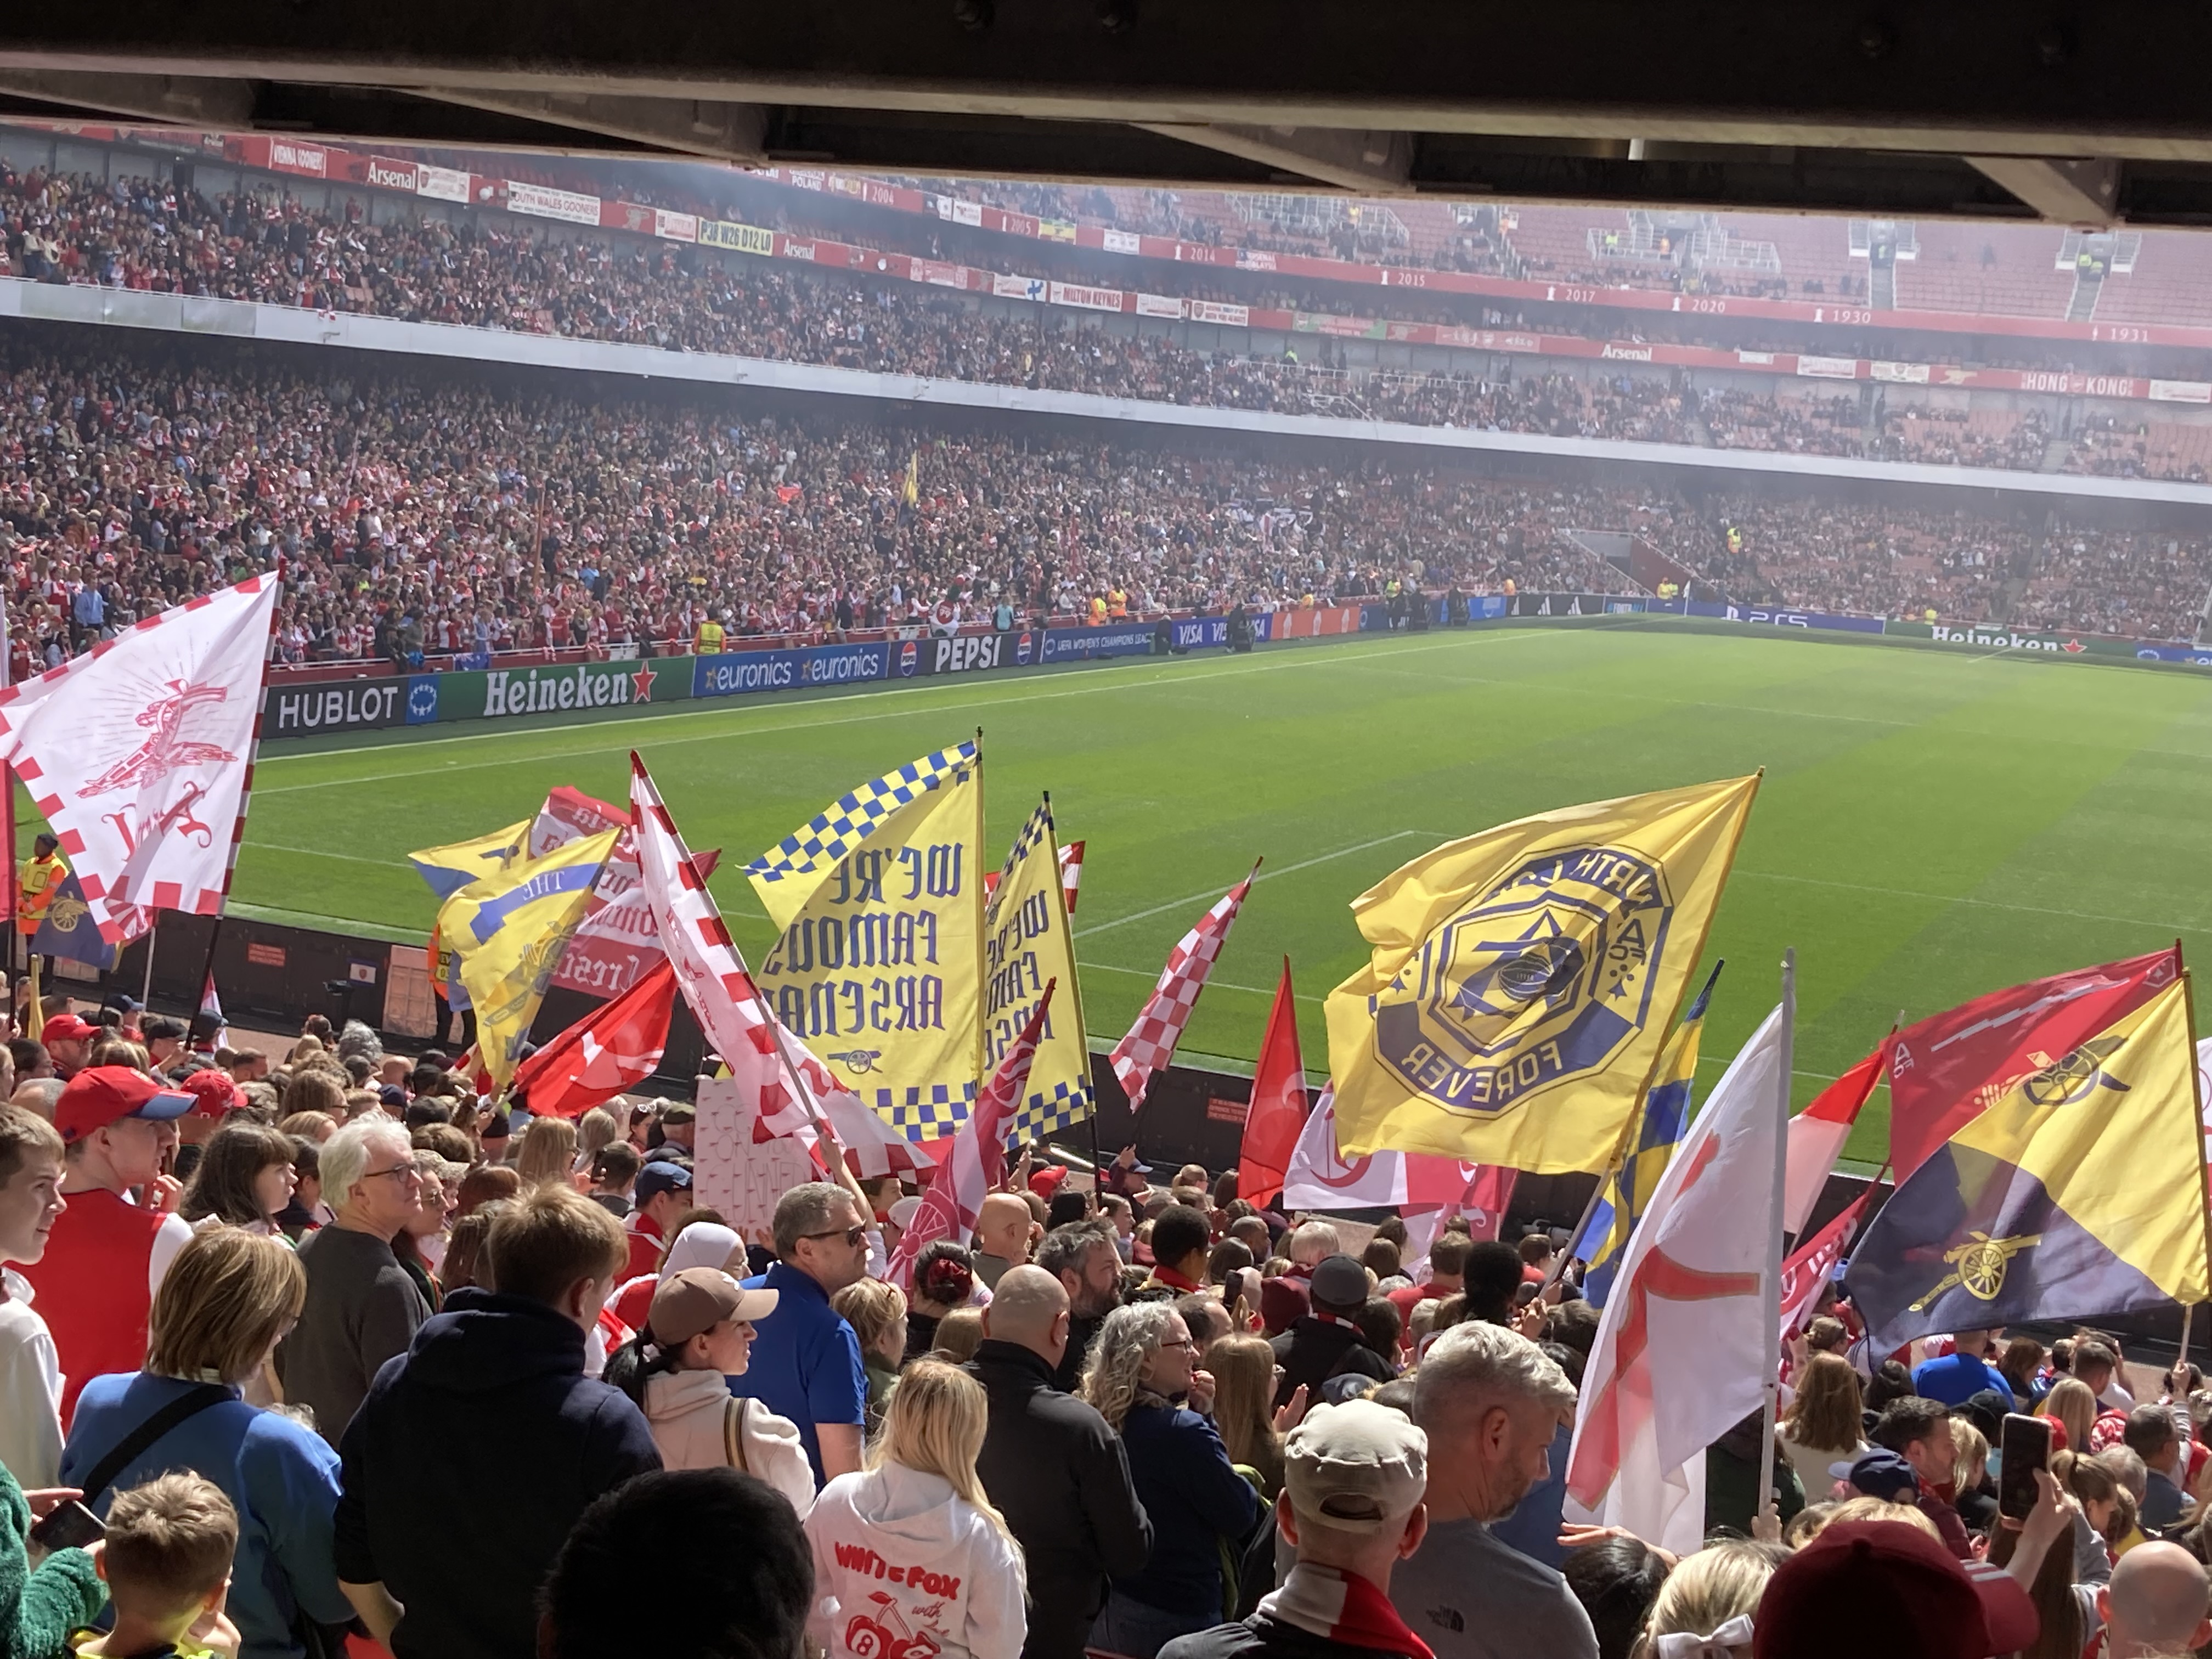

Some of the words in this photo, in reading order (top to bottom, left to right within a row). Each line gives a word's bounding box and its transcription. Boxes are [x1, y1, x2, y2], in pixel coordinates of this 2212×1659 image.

[367, 162, 416, 190] Arsenal
[792, 175, 822, 191] POLAND
[537, 194, 562, 210] WALES
[564, 201, 599, 216] GOONERS
[872, 186, 894, 205] 2004
[1011, 217, 1031, 235] 2005
[742, 228, 759, 250] D12
[783, 239, 815, 261] Arsenal
[1190, 247, 1215, 262] 2014
[1398, 273, 1425, 287] 2015
[1063, 287, 1091, 304] MILTON
[1093, 291, 1121, 308] KEYNES
[1565, 289, 1595, 303] 2017
[1692, 300, 1726, 313] 2020
[1833, 311, 1871, 324] 1930
[2111, 328, 2149, 342] 1931
[1601, 344, 1652, 362] Arsenal
[2027, 373, 2068, 392] HONG
[2086, 376, 2128, 396] KONG
[1101, 633, 1134, 648] CHAMPIONS
[1178, 623, 1203, 645] VISA
[1211, 622, 1228, 642] VIS
[1251, 618, 1266, 637] SA
[935, 635, 1002, 673] PEPSI
[717, 655, 792, 691] euronics
[811, 647, 879, 681] euronics
[483, 665, 629, 716] Heineken
[278, 686, 399, 729] HUBLOT
